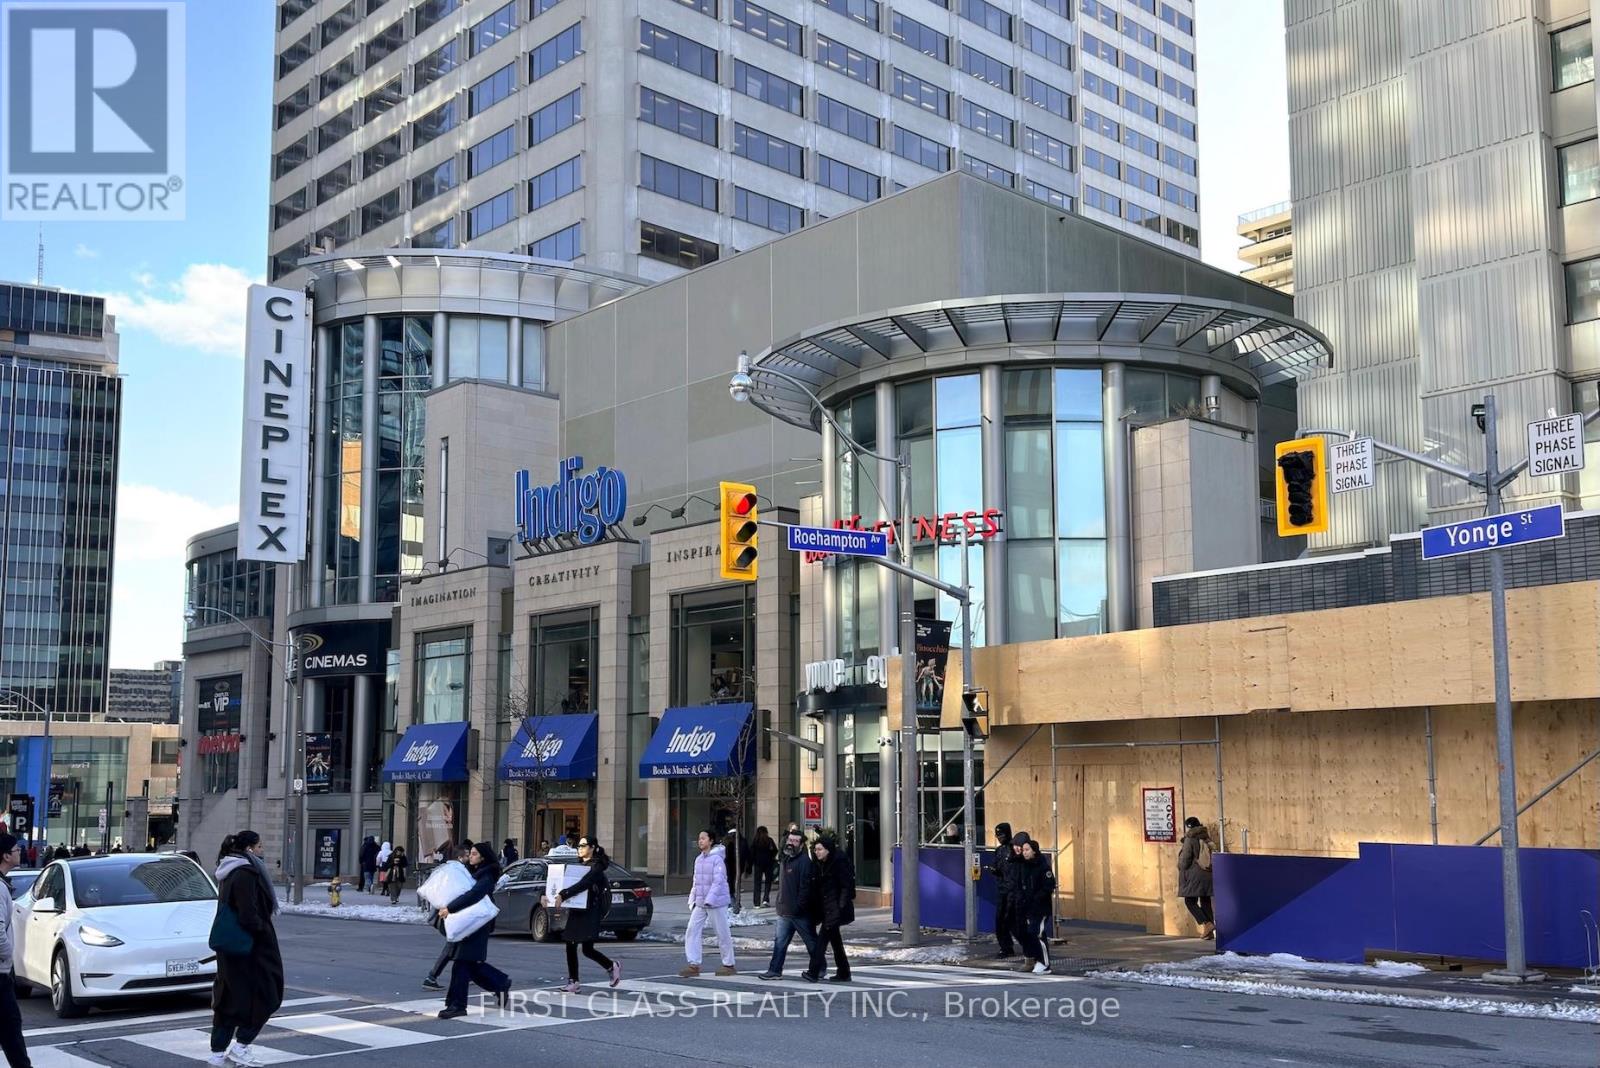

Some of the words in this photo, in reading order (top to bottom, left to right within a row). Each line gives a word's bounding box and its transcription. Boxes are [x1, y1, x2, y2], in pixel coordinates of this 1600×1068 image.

[257, 296, 293, 552] CINEPLEX
[1535, 418, 1574, 437] THREE
[1336, 441, 1367, 458] THREE
[1536, 436, 1576, 455] PHASE
[1336, 457, 1368, 474] PHASE
[1535, 454, 1579, 473] SIGNAL
[1336, 473, 1371, 490] SIGNAL
[515, 455, 628, 545] Indigo
[1446, 520, 1513, 546] Yonge
[1520, 513, 1533, 525] St
[794, 528, 867, 551] Roehampton
[870, 534, 881, 544] Av
[667, 544, 722, 563] INSPIRA
[529, 565, 600, 587] CREATIVITY
[411, 587, 477, 607] IMAGINATION
[917, 643, 948, 653] inocchio
[304, 654, 368, 669] CINEMAS
[214, 697, 230, 712] VIP
[521, 732, 563, 762] Indigo
[665, 726, 716, 757] Indigo
[402, 739, 439, 766] Indigo
[652, 765, 671, 775] Books
[672, 765, 691, 775] Music
[808, 801, 819, 817] R
[15, 816, 27, 830] P
